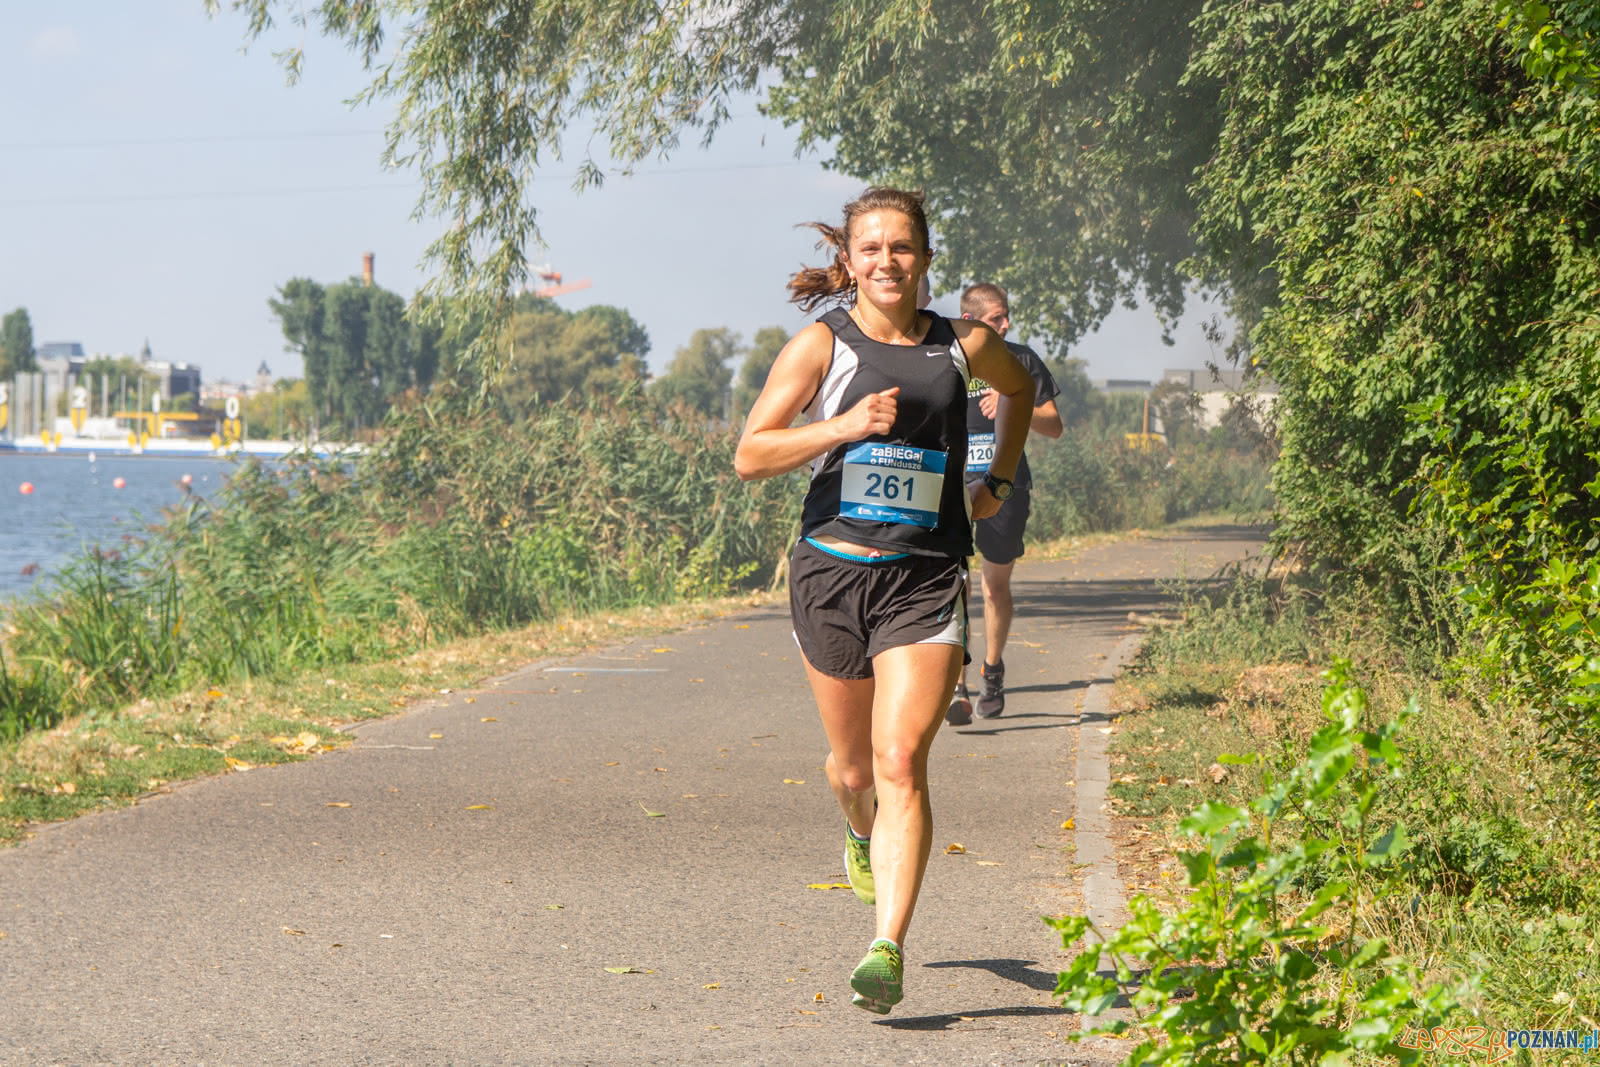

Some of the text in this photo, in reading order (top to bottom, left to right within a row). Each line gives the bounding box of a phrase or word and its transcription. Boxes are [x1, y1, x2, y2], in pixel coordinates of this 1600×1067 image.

[871, 447, 924, 463] zaBIEGaj
[969, 448, 993, 461] 120
[864, 472, 914, 502] 261
